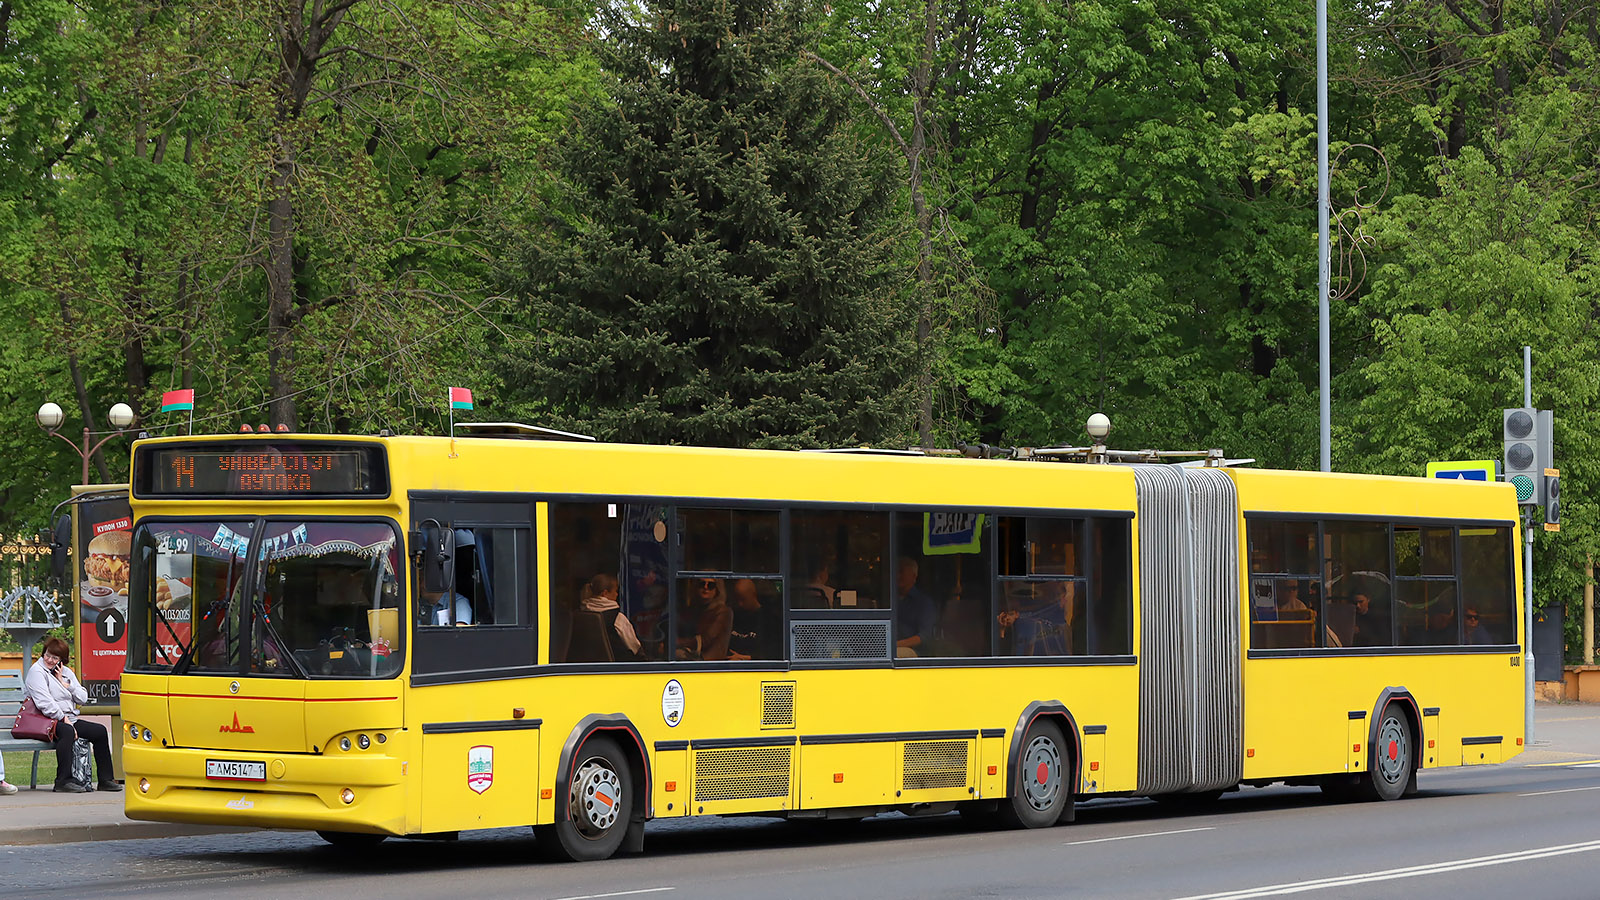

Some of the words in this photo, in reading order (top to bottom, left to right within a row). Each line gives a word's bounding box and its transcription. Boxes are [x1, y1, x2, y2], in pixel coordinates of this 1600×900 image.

[172, 456, 194, 488] 14
[97, 522, 115, 533] КУПОН
[115, 519, 129, 529] 1330
[92, 649, 99, 657] ТЦ
